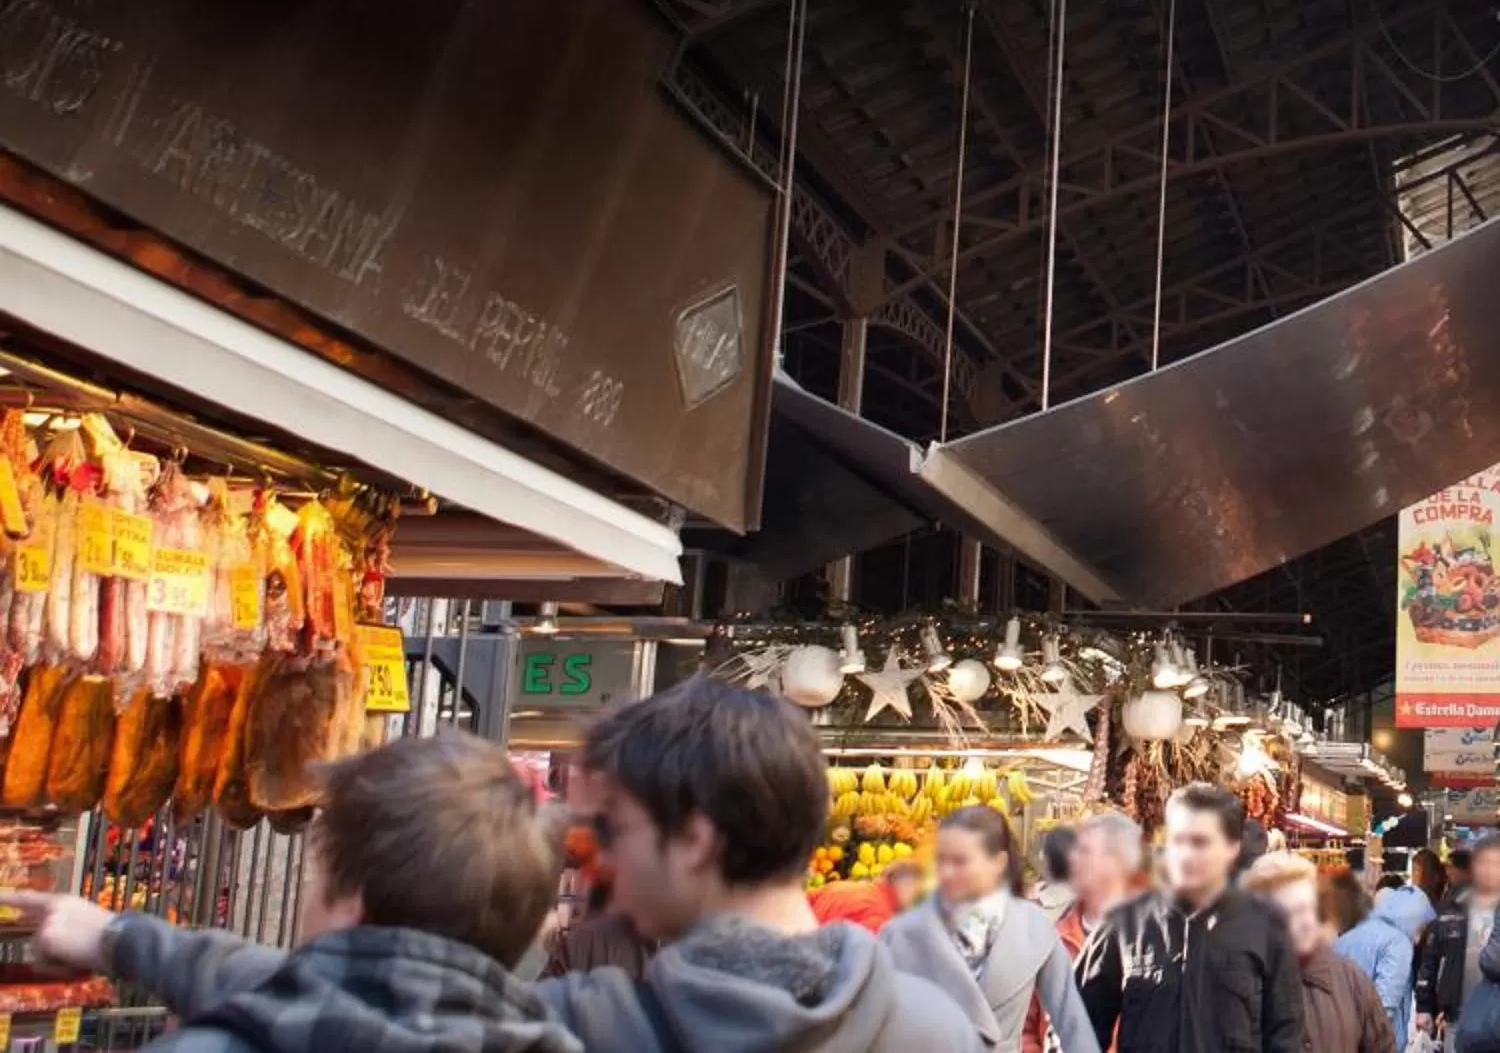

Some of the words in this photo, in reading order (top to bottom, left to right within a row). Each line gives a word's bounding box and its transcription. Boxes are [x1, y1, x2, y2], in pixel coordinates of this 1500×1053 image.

[1458, 490, 1481, 504] LA
[1413, 504, 1493, 525] COMPRA
[1415, 701, 1465, 716] Estrella
